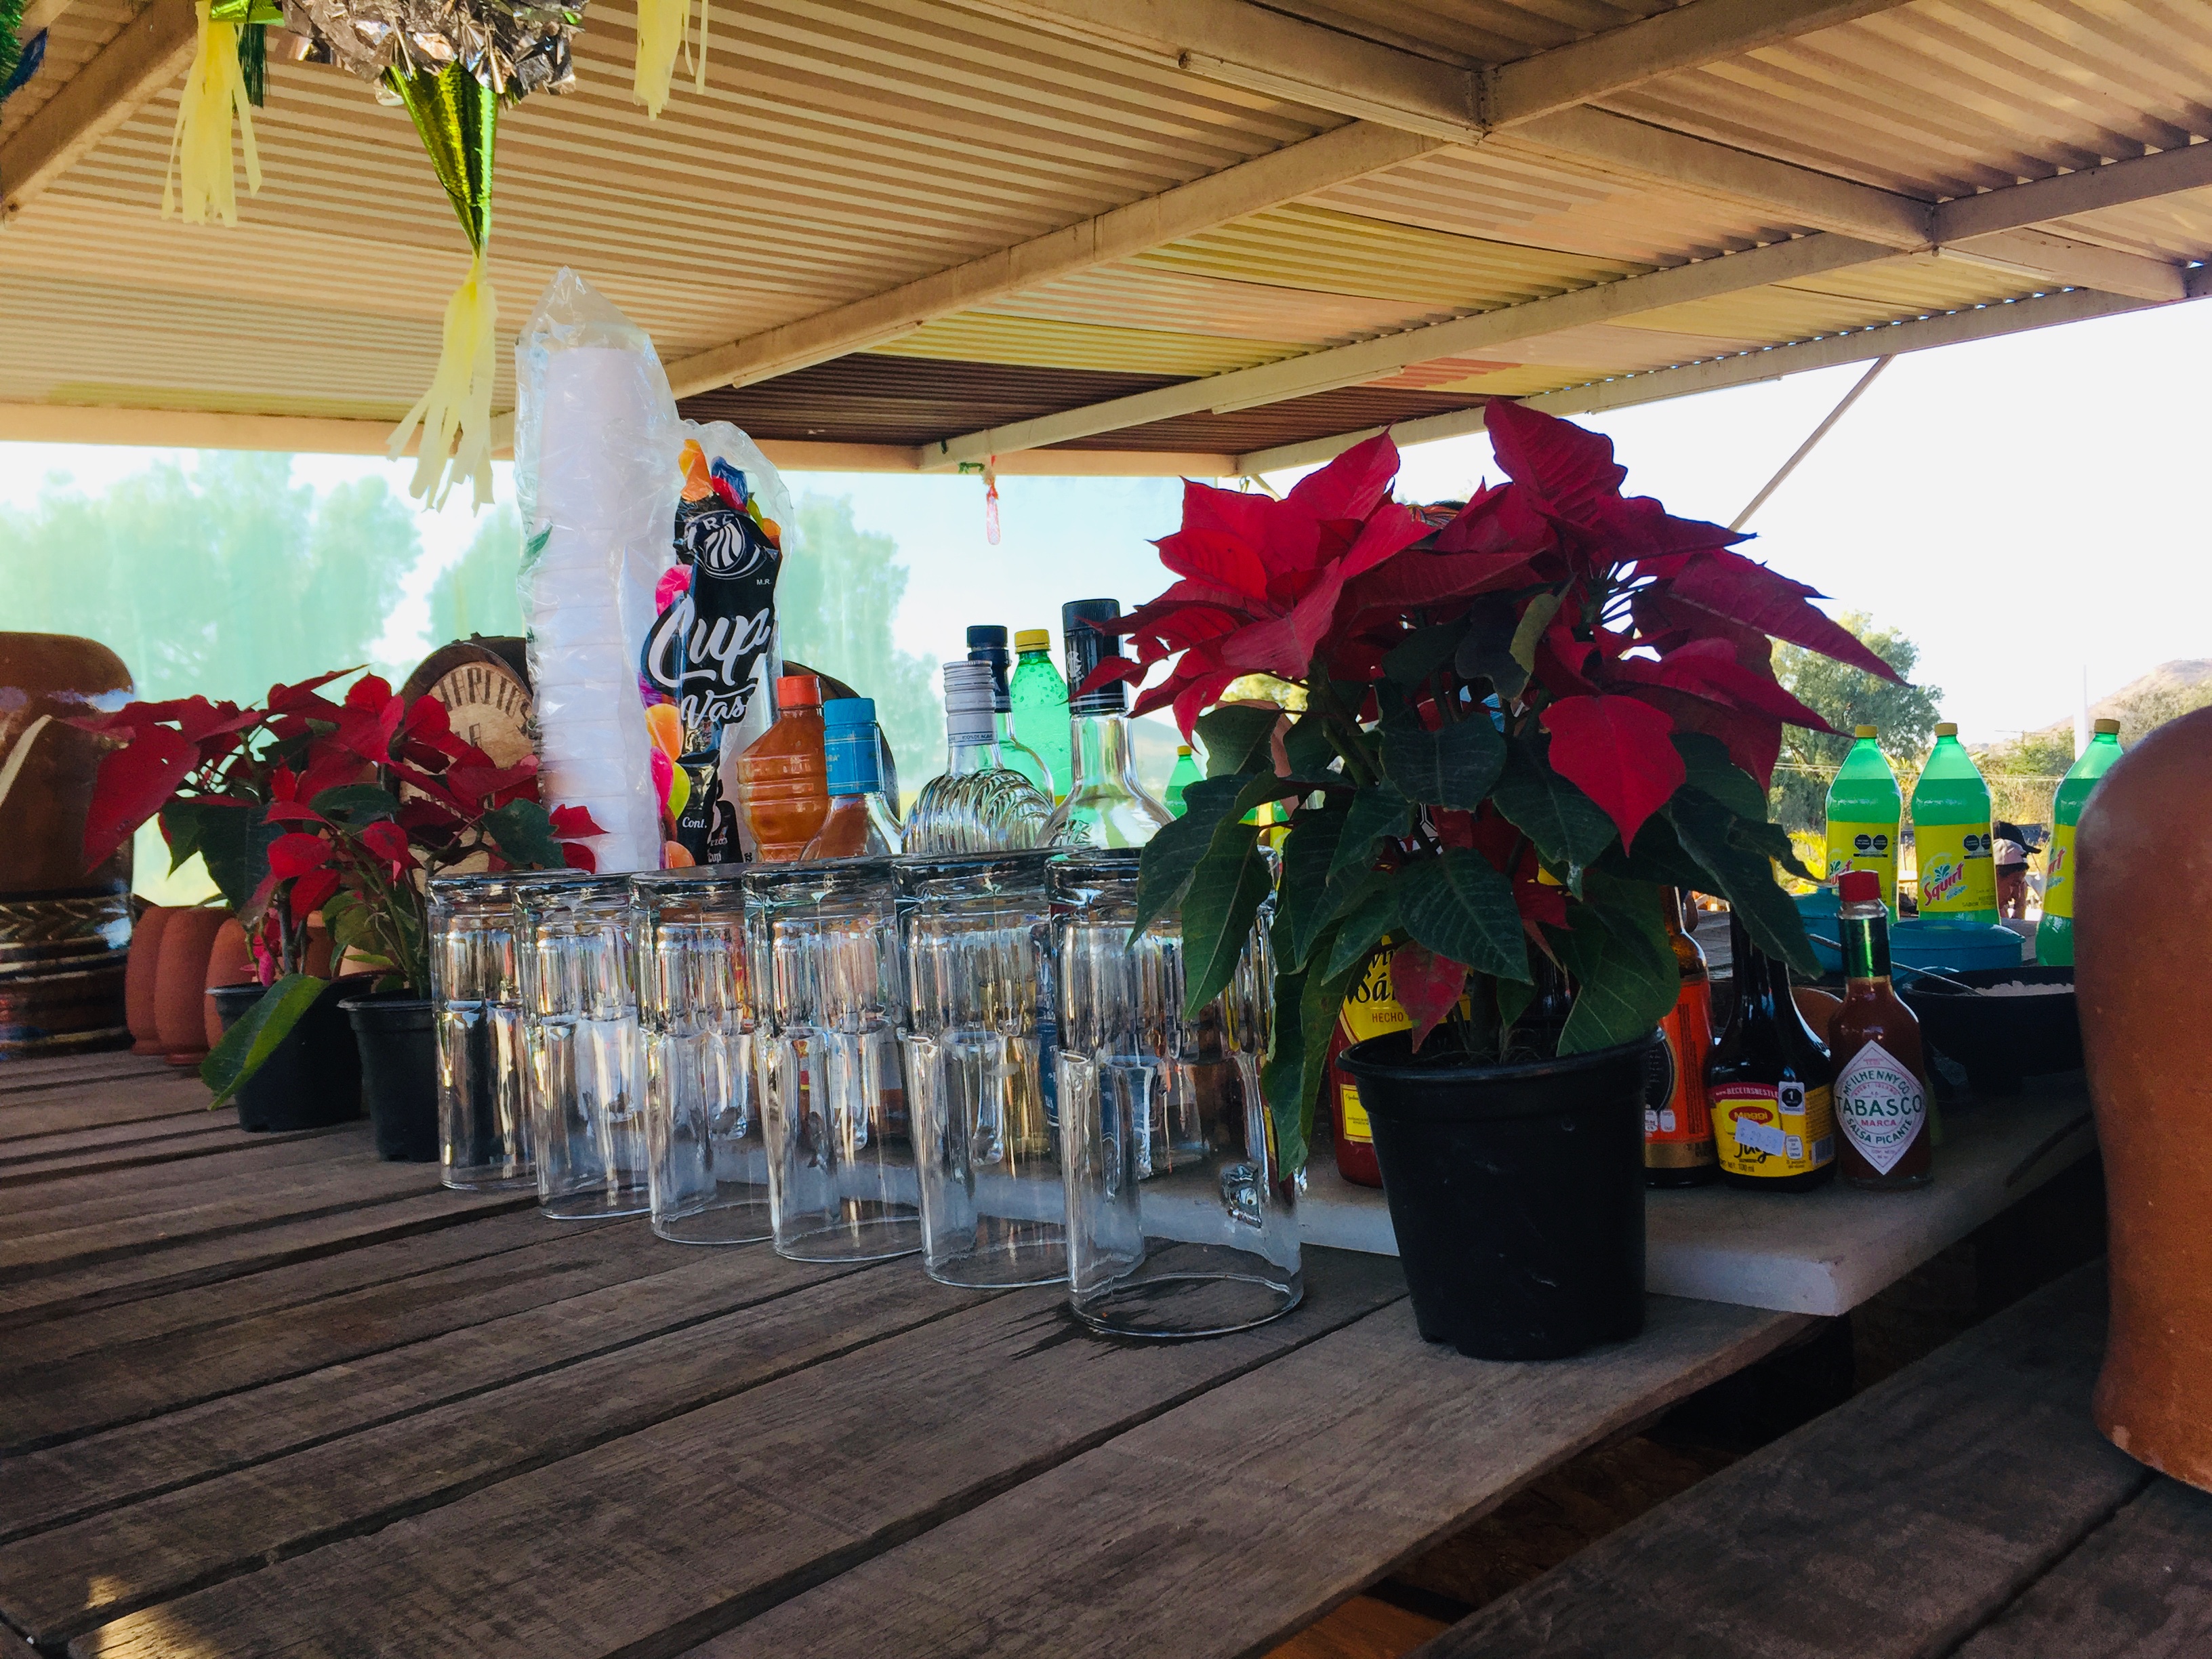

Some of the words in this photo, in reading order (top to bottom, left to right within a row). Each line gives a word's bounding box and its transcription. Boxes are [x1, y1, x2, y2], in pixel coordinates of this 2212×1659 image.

[1923, 861, 1965, 907] Squirt
[1372, 1012, 1404, 1023] HECHO
[1734, 1111, 1768, 1120] Maggi
[1835, 1094, 1922, 1117] TABASCO
[1847, 1118, 1872, 1143] SALSA
[1876, 1118, 1912, 1144] PICANTE
